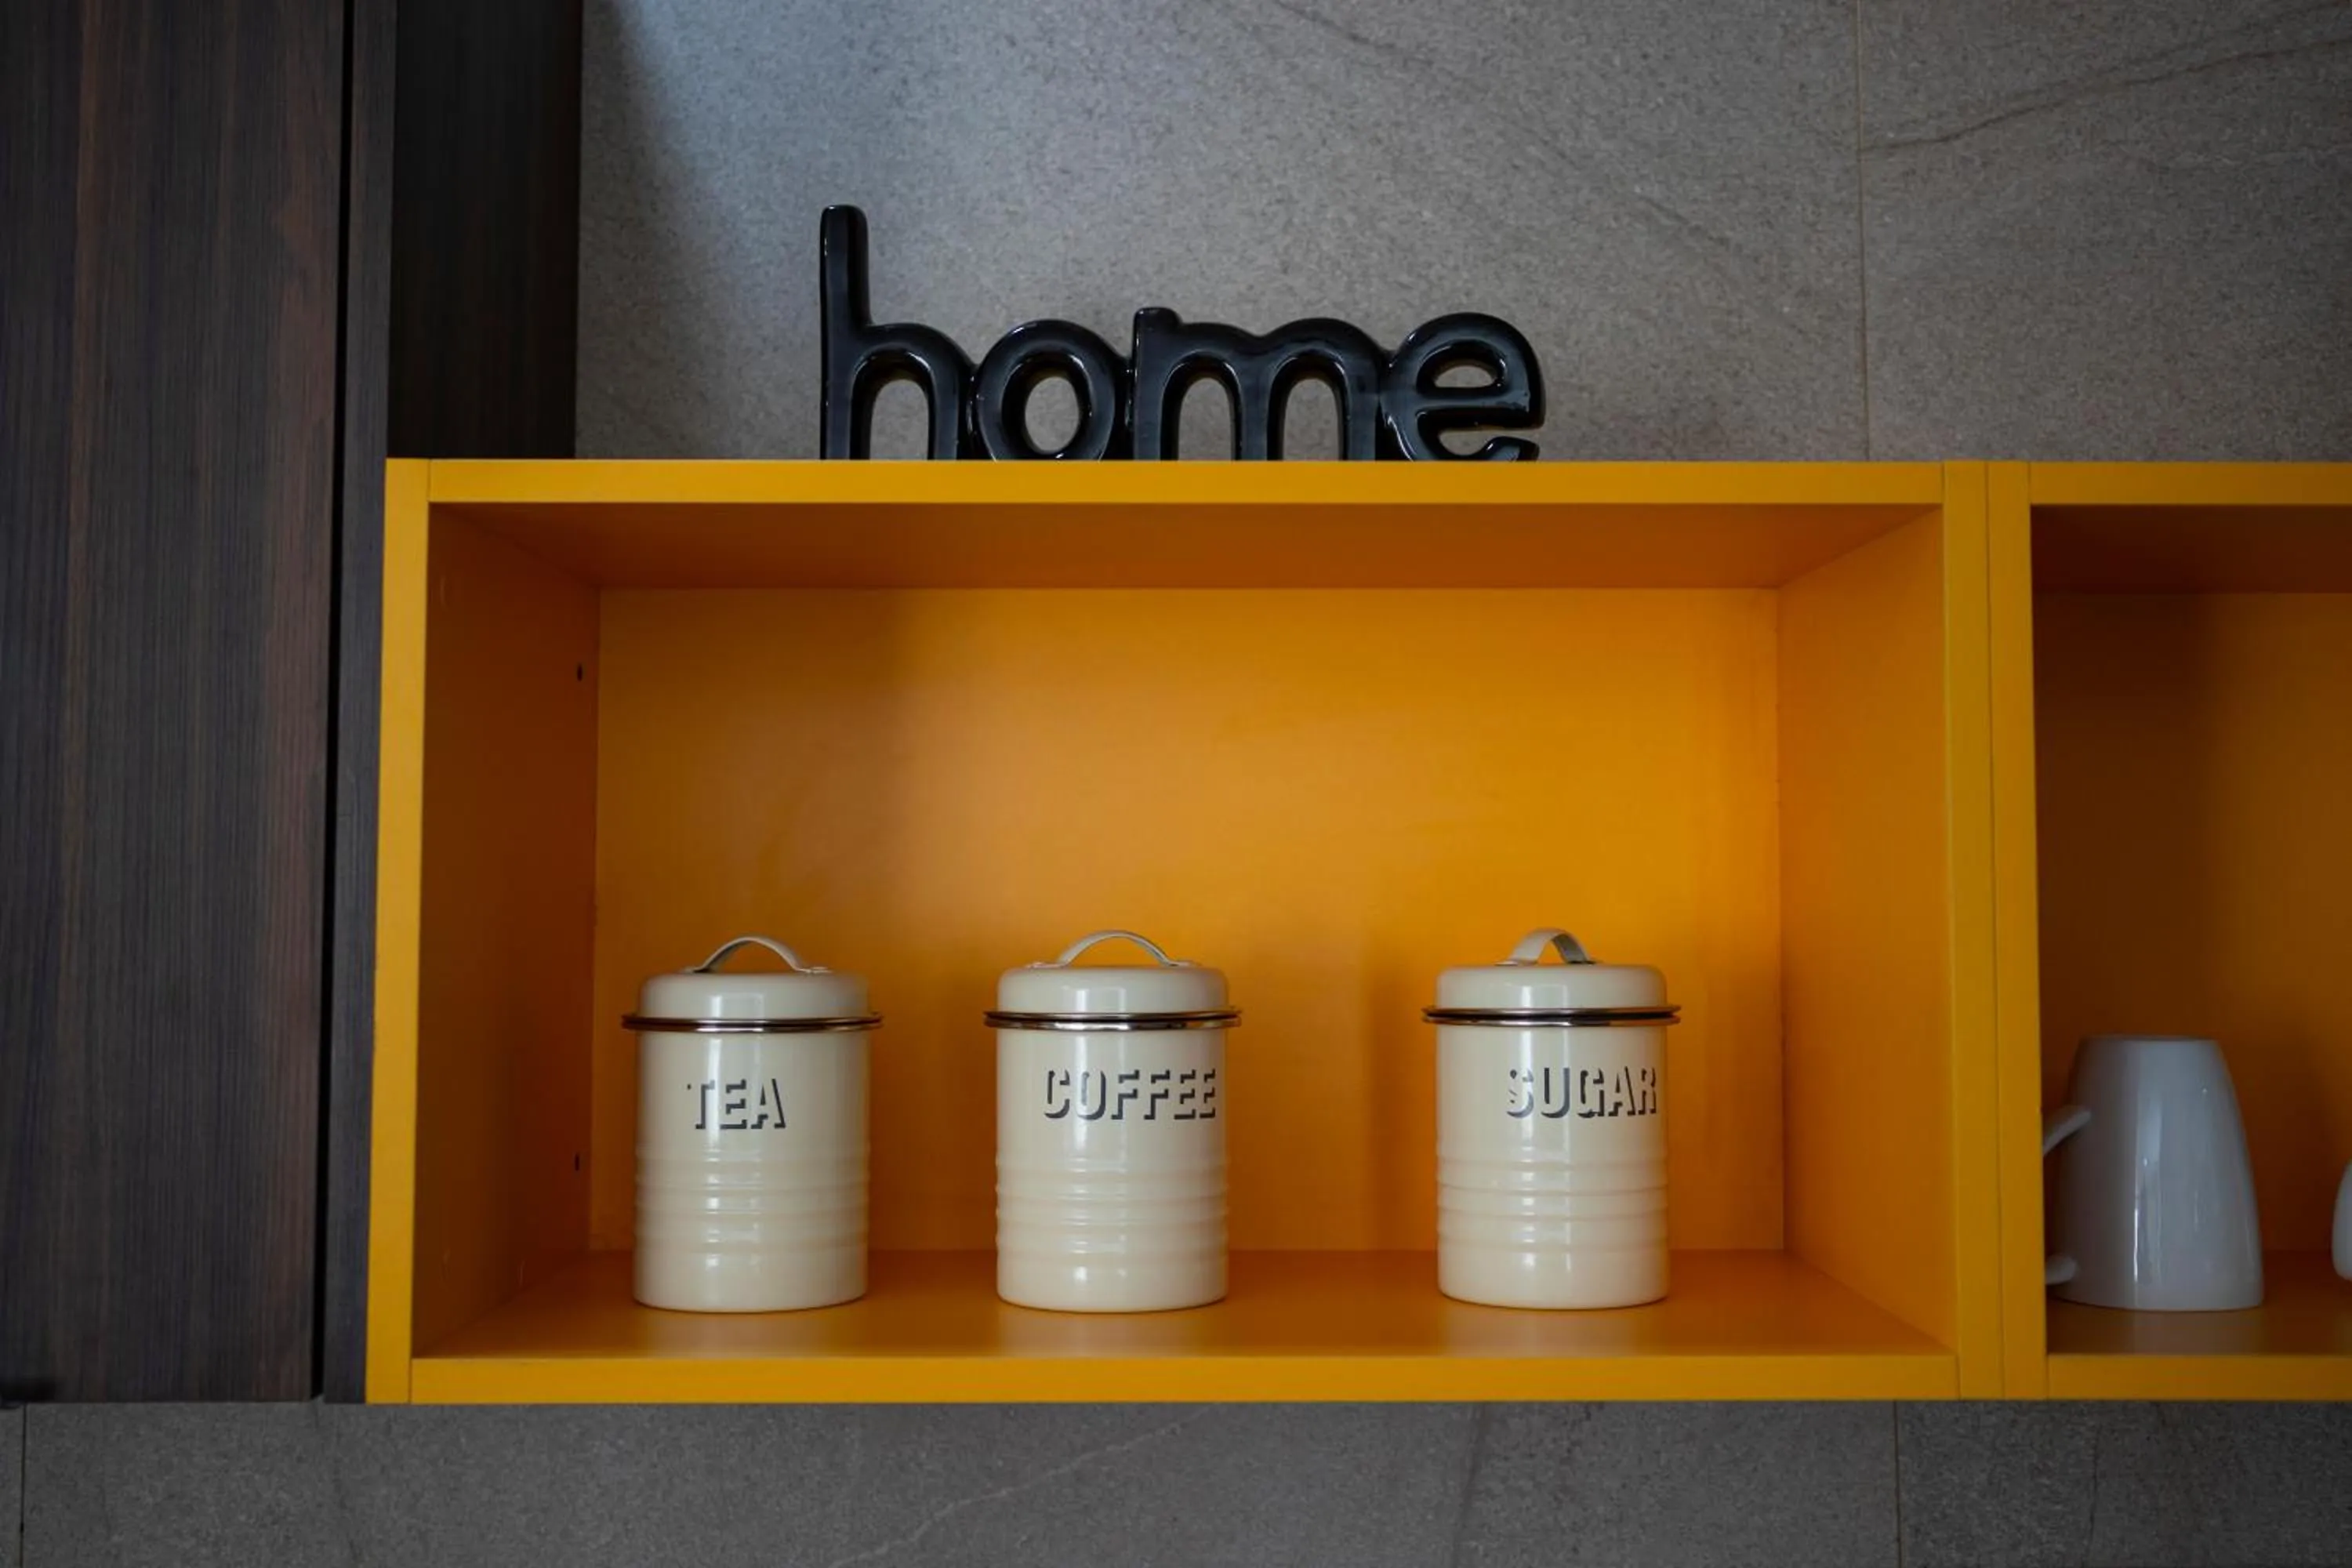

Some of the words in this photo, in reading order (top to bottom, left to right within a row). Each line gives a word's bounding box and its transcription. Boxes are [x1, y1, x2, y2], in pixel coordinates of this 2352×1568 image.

[820, 205, 1544, 461] home
[687, 1079, 786, 1129] TEA
[1044, 1069, 1216, 1120] COFFEE
[1506, 1066, 1657, 1119] SUGAR
